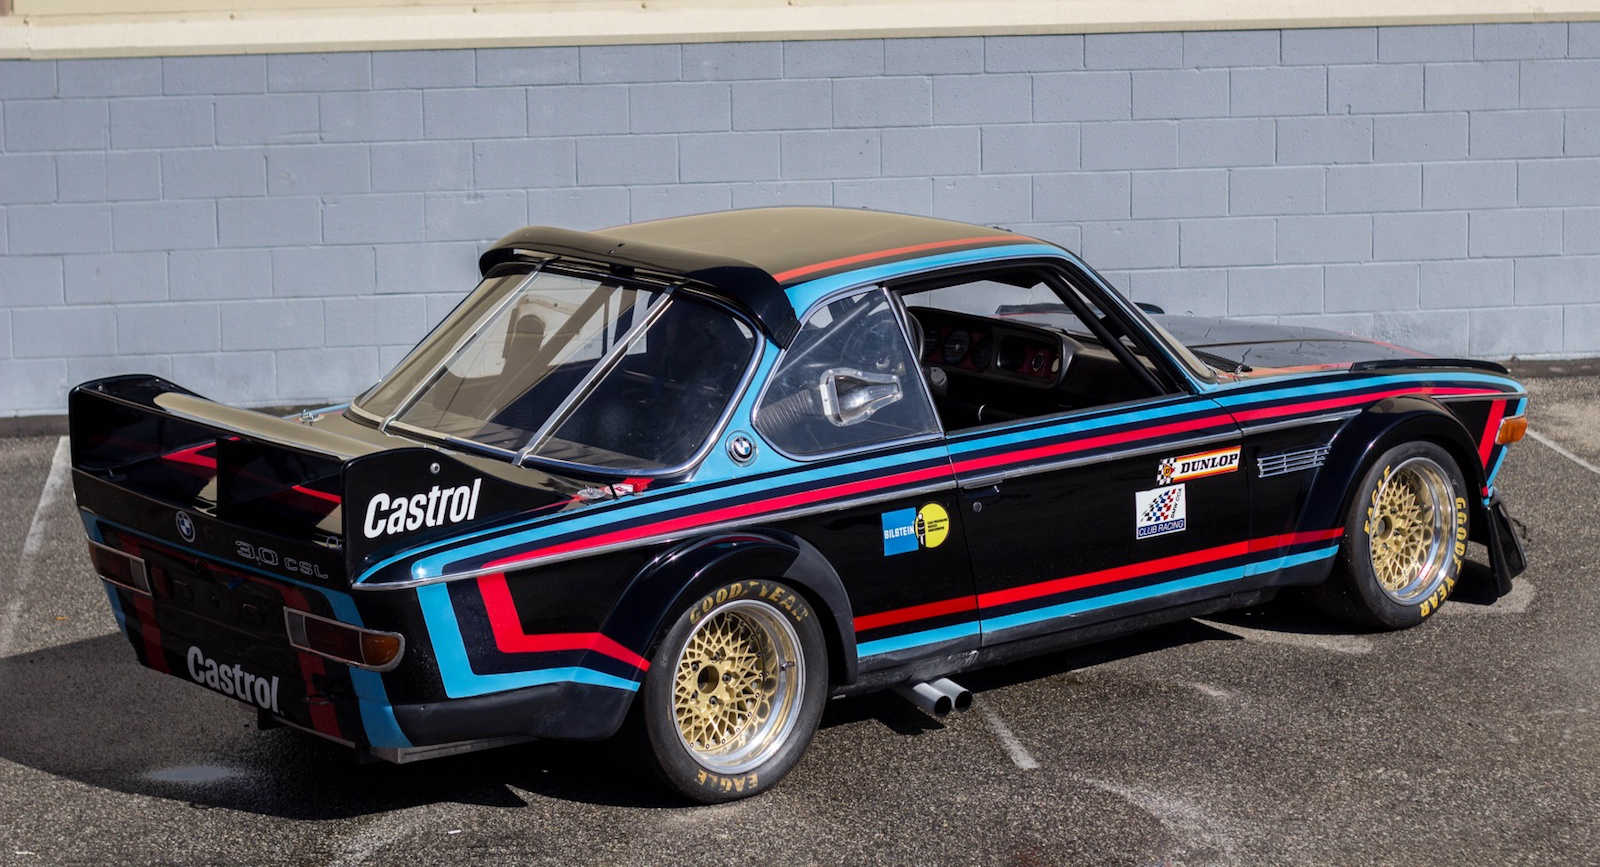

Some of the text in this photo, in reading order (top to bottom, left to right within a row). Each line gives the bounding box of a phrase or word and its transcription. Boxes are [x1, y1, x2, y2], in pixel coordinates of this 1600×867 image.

[1180, 453, 1239, 474] DUNLOP
[363, 478, 482, 539] Castrol
[884, 525, 915, 540] BILSTEIN
[1138, 519, 1184, 537] CLUB RACING
[284, 557, 329, 580] CSL
[187, 645, 280, 713] Castrol
